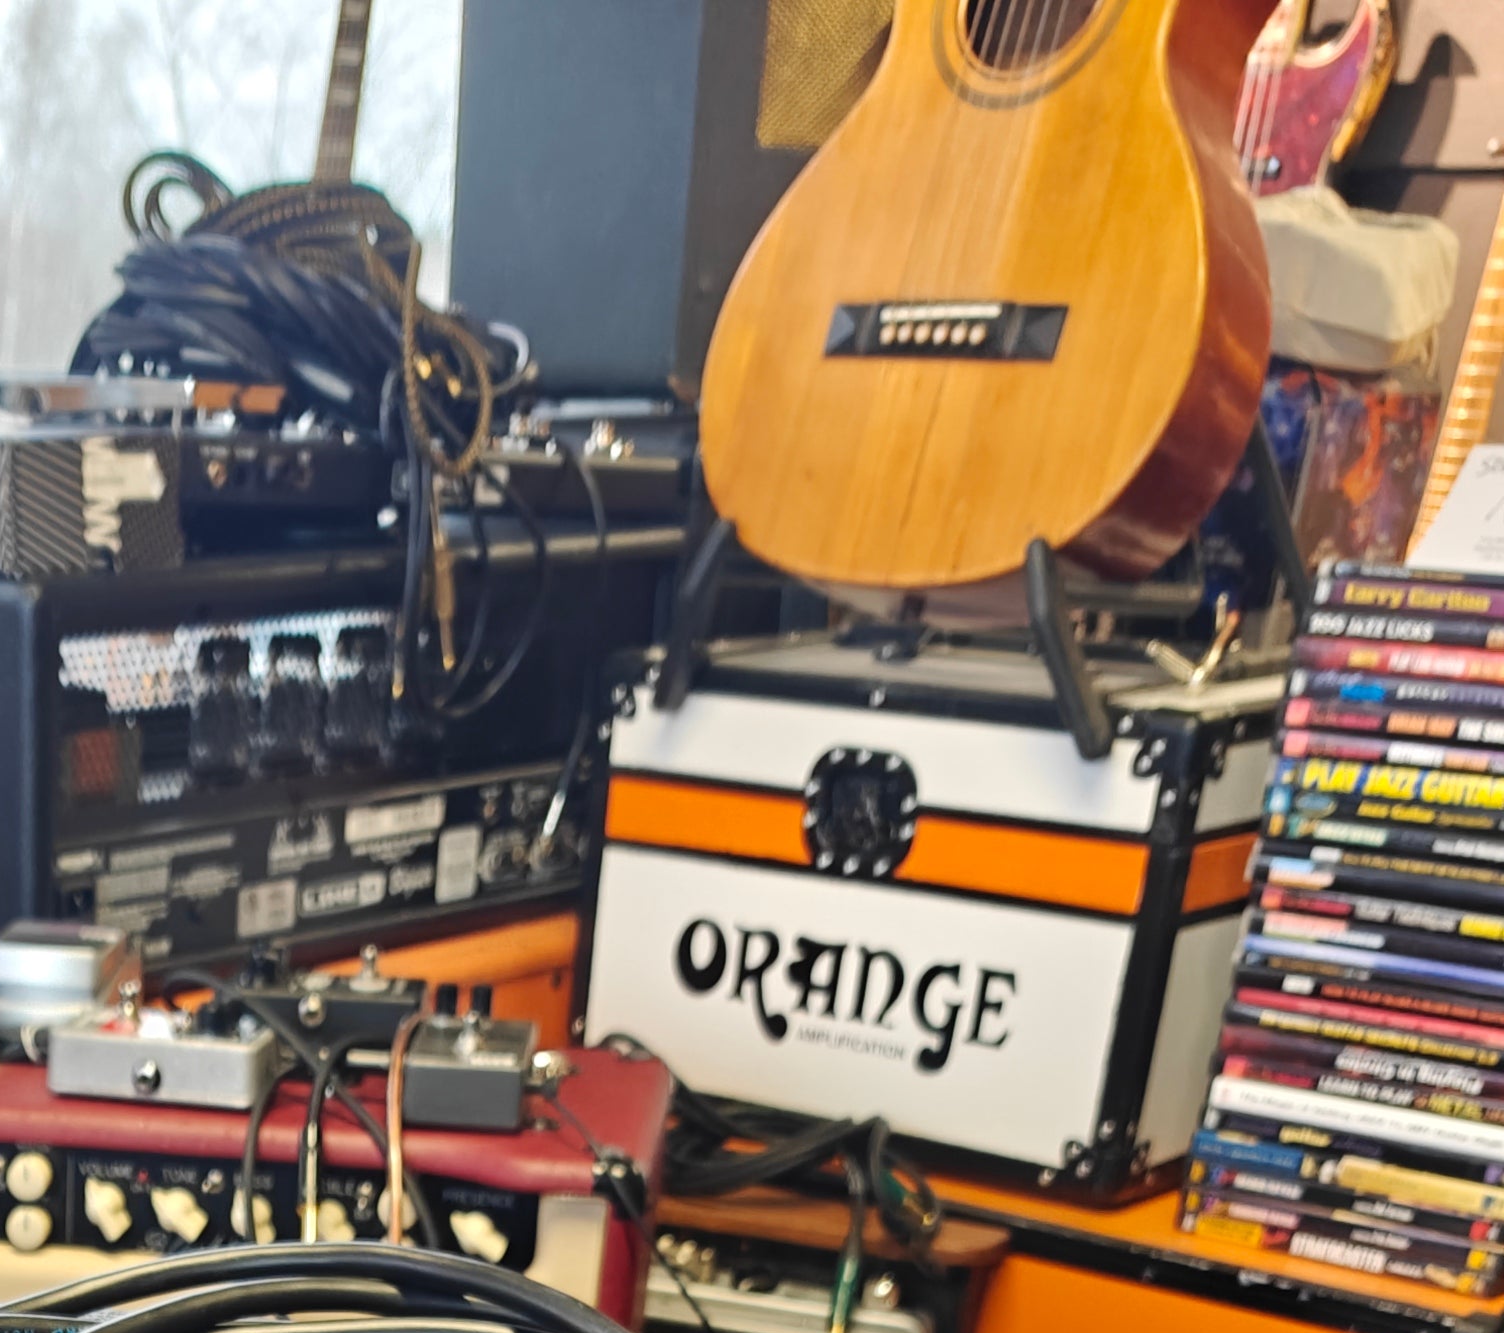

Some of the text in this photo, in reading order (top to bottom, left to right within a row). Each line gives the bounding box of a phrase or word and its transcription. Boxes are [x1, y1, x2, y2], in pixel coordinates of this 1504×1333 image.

[1362, 764, 1420, 799] JAZZ
[676, 919, 1017, 1072] ORANGE
[798, 1025, 906, 1061] AMPLIFICATION
